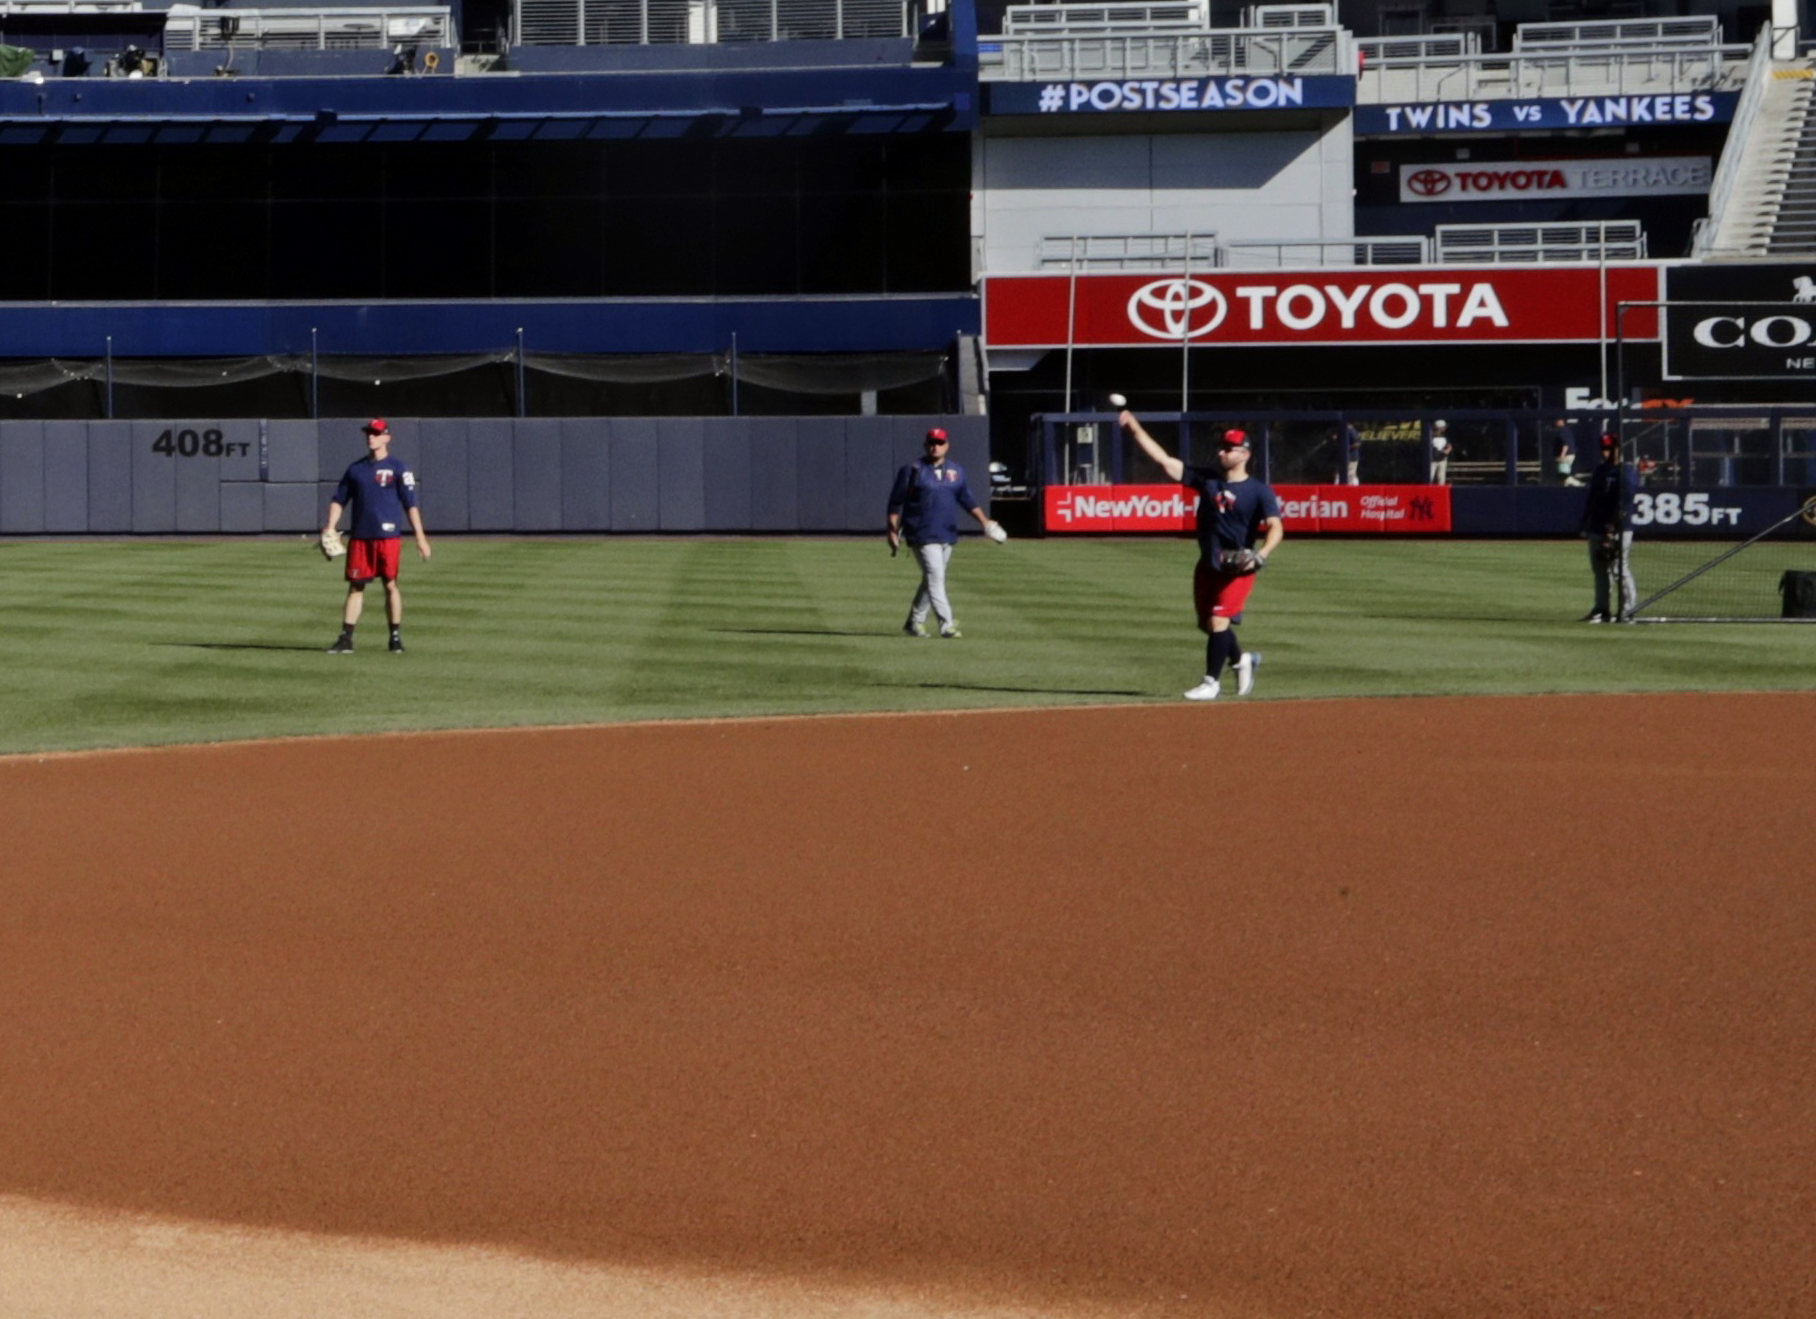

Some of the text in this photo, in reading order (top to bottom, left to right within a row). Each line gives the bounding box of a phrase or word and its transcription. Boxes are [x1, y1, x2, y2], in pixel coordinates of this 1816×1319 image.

[1038, 78, 1304, 112] #POSTSEASON
[1385, 103, 1493, 131] TWINS
[1560, 95, 1715, 124] YANKEES
[1454, 163, 1711, 192] TOYOTA TERRACE
[1237, 283, 1508, 330] TOYOTA
[1693, 315, 1816, 348] CO
[1360, 495, 1398, 507] Official
[1360, 508, 1406, 522] Hospital
